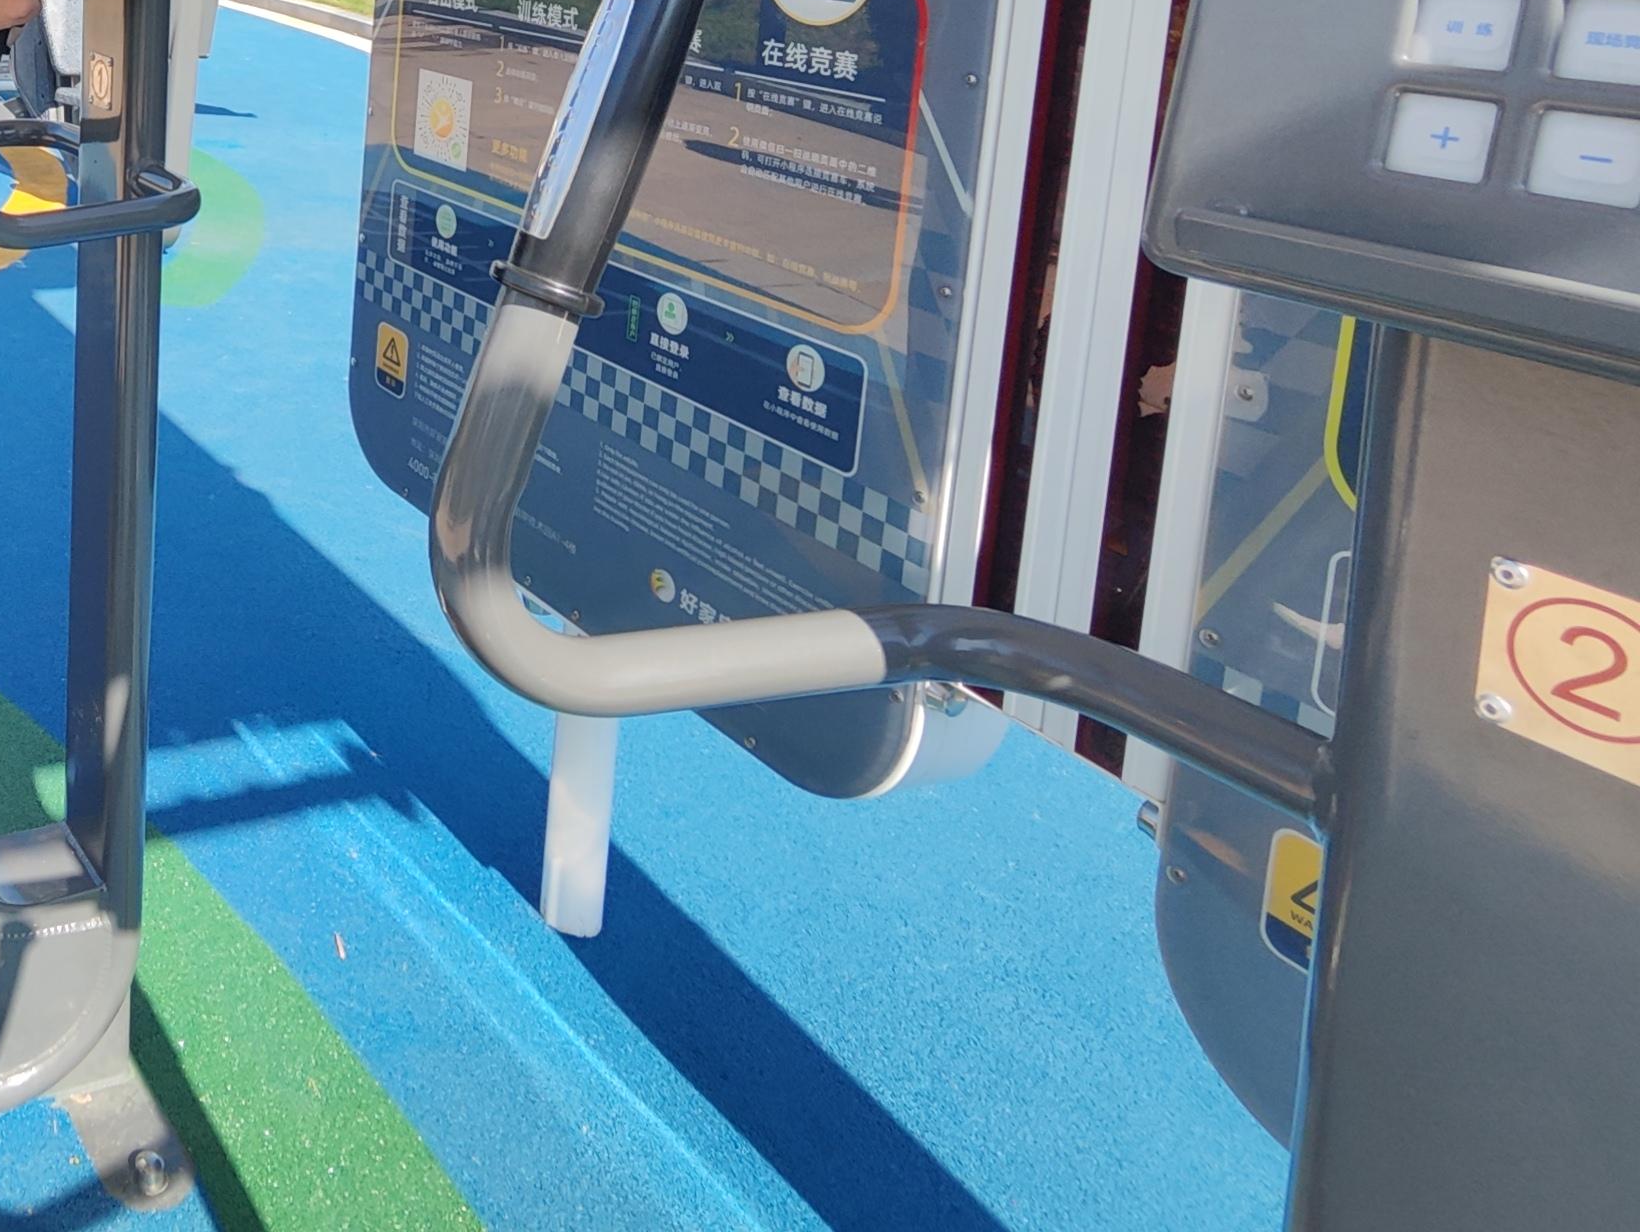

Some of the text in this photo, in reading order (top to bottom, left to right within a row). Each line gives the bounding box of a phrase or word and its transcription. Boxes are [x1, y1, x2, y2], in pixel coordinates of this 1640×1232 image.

[761, 38, 859, 82] 在线竞赛
[734, 82, 742, 102] 1
[728, 126, 739, 147] 2
[777, 385, 828, 419] 查看数据
[680, 588, 731, 625] 好家
[1550, 626, 1628, 722] 2
